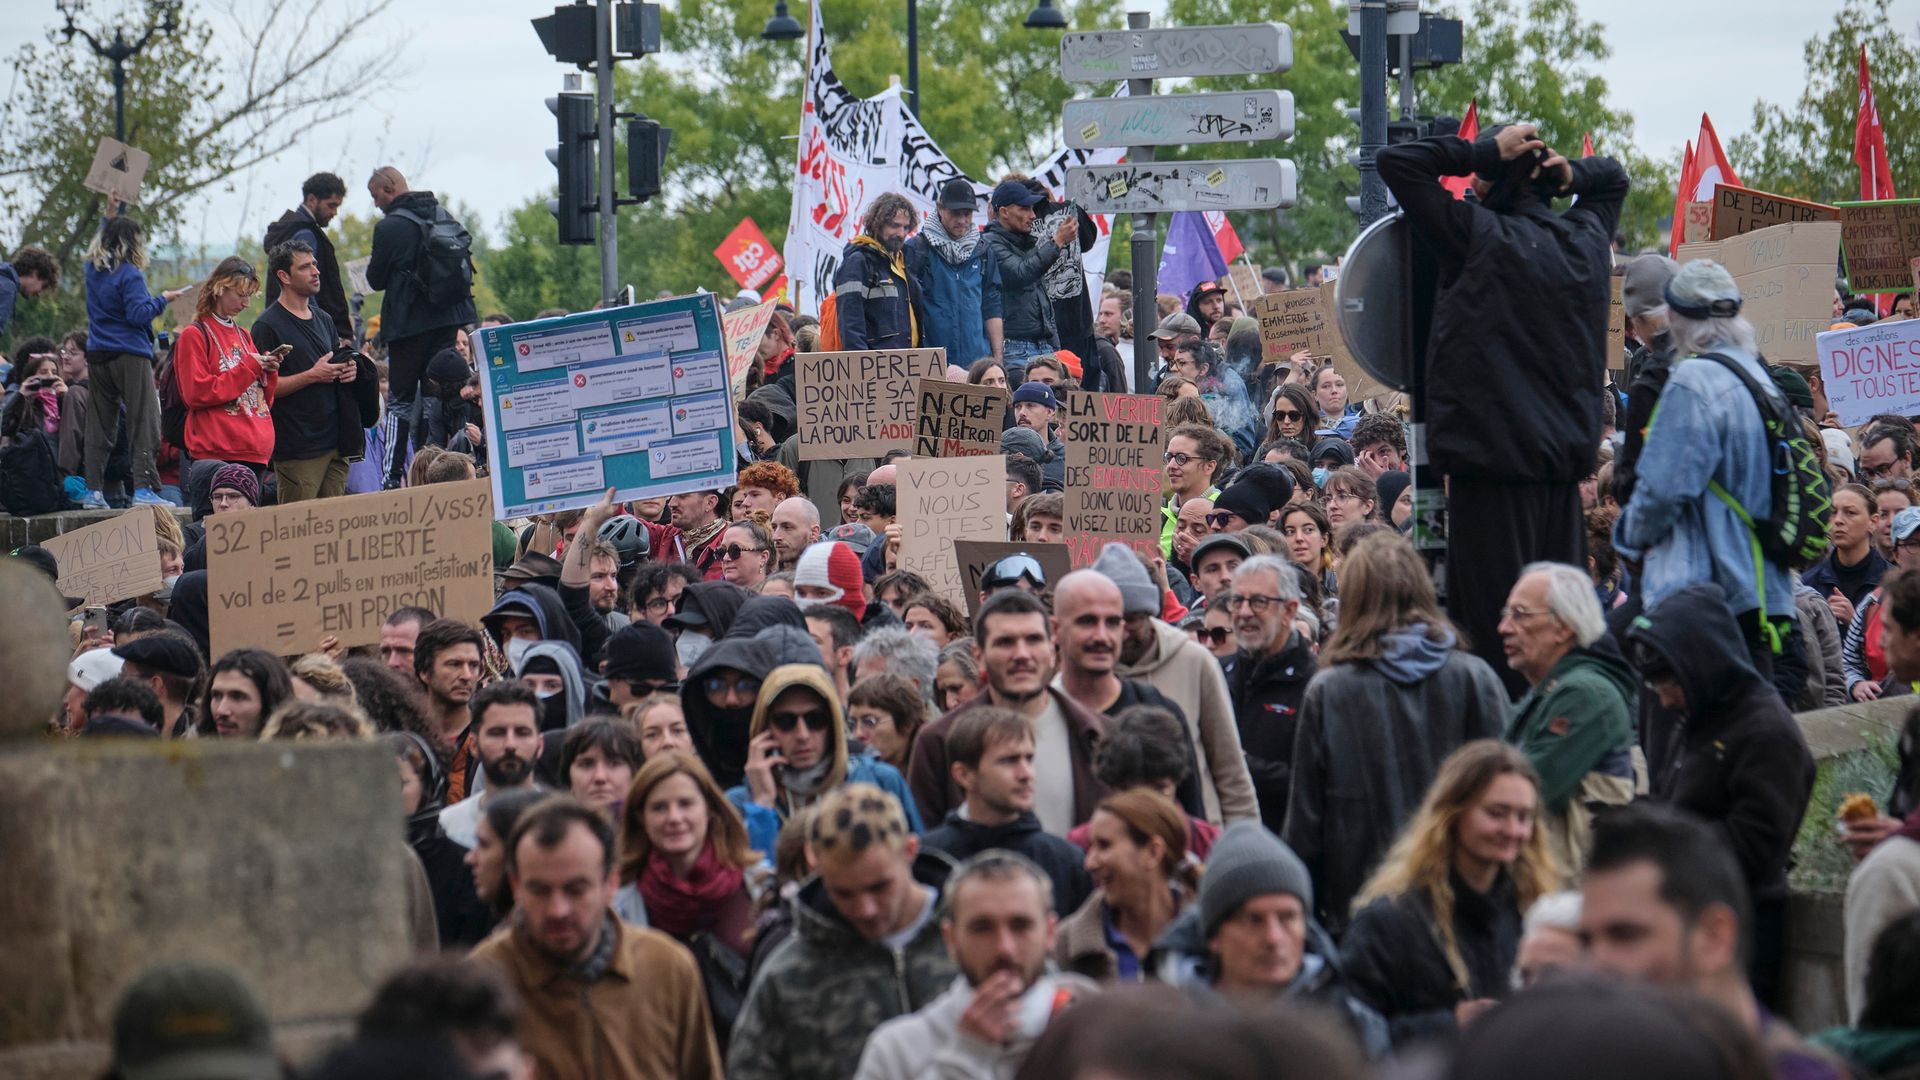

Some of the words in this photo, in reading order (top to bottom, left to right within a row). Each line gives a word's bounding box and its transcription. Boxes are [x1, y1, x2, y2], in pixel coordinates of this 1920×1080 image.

[1723, 190, 1746, 211] DE
[1752, 196, 1823, 222] BATTRE
[1265, 299, 1280, 313] La
[1284, 296, 1316, 313] jeunesse
[1262, 312, 1310, 328] EMMERDE
[1264, 322, 1325, 341] Rassemblement
[1845, 332, 1860, 346] des
[1864, 328, 1899, 343] conditions
[803, 356, 850, 383] MON
[860, 351, 921, 380] PÈRE
[927, 351, 943, 377] A
[1832, 340, 1920, 378] DIGNES
[805, 376, 877, 404] DONNÉ
[886, 379, 914, 399] SA
[1850, 371, 1920, 400] TOUSTE
[805, 400, 885, 425] SANTÉ,
[889, 400, 916, 422] JE
[921, 392, 947, 415] Ni
[1070, 394, 1096, 417] LA
[1102, 395, 1164, 426] VERITE
[800, 426, 822, 444] LA
[824, 425, 866, 444] POUR
[919, 415, 943, 438] Ni
[1068, 421, 1110, 443] SORT
[1116, 423, 1133, 444] DE
[1139, 425, 1158, 445] LA
[917, 437, 940, 458] Ni
[1089, 446, 1144, 467] BOUCHE
[909, 469, 990, 489] VOUS
[1066, 466, 1090, 487] DES
[1093, 466, 1162, 493] ENFANTS
[919, 492, 981, 515] NOUS
[1081, 491, 1114, 511] DONC
[1117, 494, 1152, 515] VOUS
[212, 520, 250, 555] 32
[260, 509, 334, 553] plaintes
[339, 515, 378, 539] pour
[382, 497, 413, 525] viol
[914, 516, 993, 538] DITES
[1070, 513, 1108, 532] VISEZ
[1115, 515, 1152, 534] LEURS
[314, 541, 339, 566] EN
[347, 519, 437, 563] LIBERTÉ
[940, 535, 967, 552] D
[107, 561, 131, 579] TA
[219, 581, 252, 610] vol
[262, 576, 286, 605] de
[293, 578, 311, 601] 2
[316, 569, 351, 606] pulls
[355, 576, 374, 592] en
[381, 552, 491, 592] manifestation?
[322, 605, 352, 632] EN
